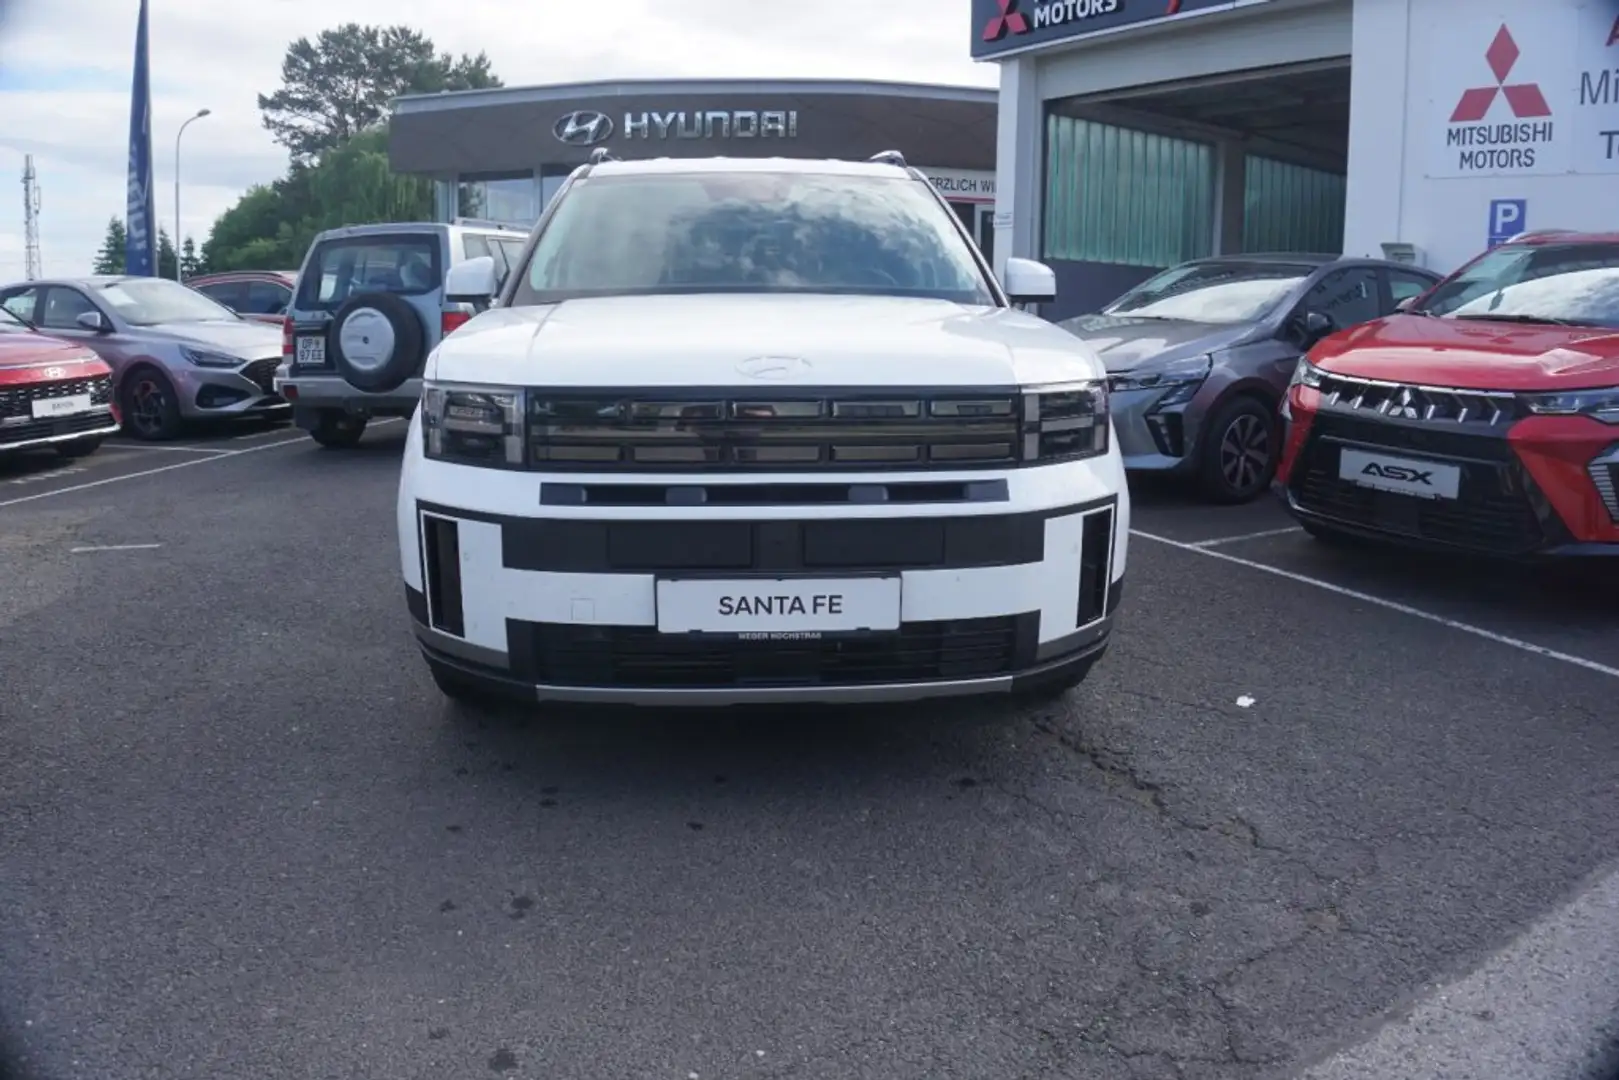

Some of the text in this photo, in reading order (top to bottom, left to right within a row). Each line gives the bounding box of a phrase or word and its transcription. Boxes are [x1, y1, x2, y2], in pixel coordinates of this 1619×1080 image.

[1034, 0, 1117, 28] MOTORS
[624, 110, 797, 139] HYUNDAI
[1447, 121, 1553, 147] MITSUBISHI
[1459, 148, 1536, 170] MOTORS
[1495, 202, 1519, 234] P
[1361, 462, 1433, 485] ASX
[718, 594, 844, 616] SANTA FE
